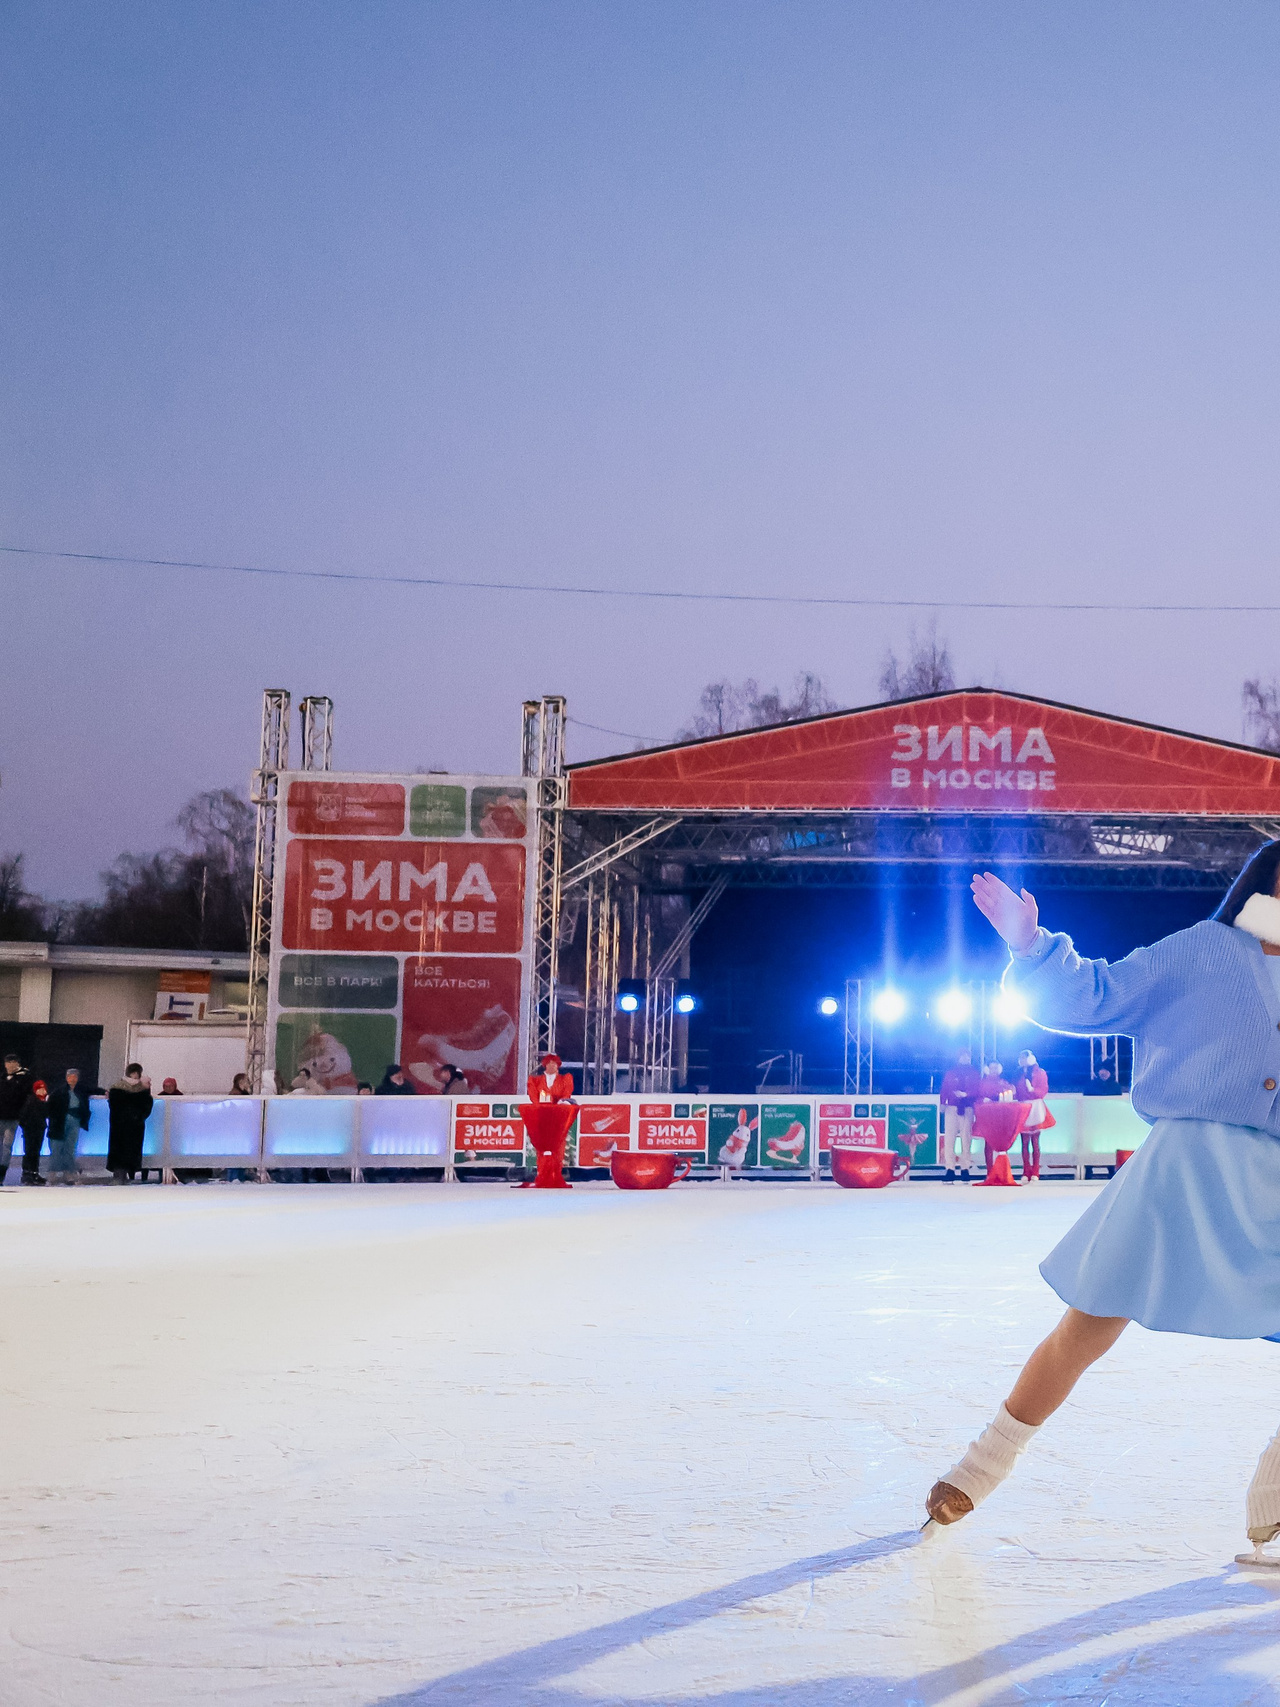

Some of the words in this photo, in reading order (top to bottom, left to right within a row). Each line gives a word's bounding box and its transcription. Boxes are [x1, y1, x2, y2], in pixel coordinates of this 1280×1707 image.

[891, 724, 1056, 763] ЗИМА
[891, 768, 911, 788] В
[923, 768, 1056, 790] МОСКВЕ
[310, 858, 498, 903] ЗИМА
[310, 908, 333, 931] В
[346, 909, 497, 934] МОСКВЕ
[415, 966, 442, 976] ВСЕ
[293, 976, 322, 986] ВСЕ
[326, 977, 336, 986] В
[340, 977, 383, 987] ПАРК!
[414, 978, 490, 989] КАТАТЬСЯ!
[464, 1124, 516, 1137] ЗИМА
[647, 1124, 697, 1137] ЗИМА
[828, 1124, 877, 1137] ЗИМА
